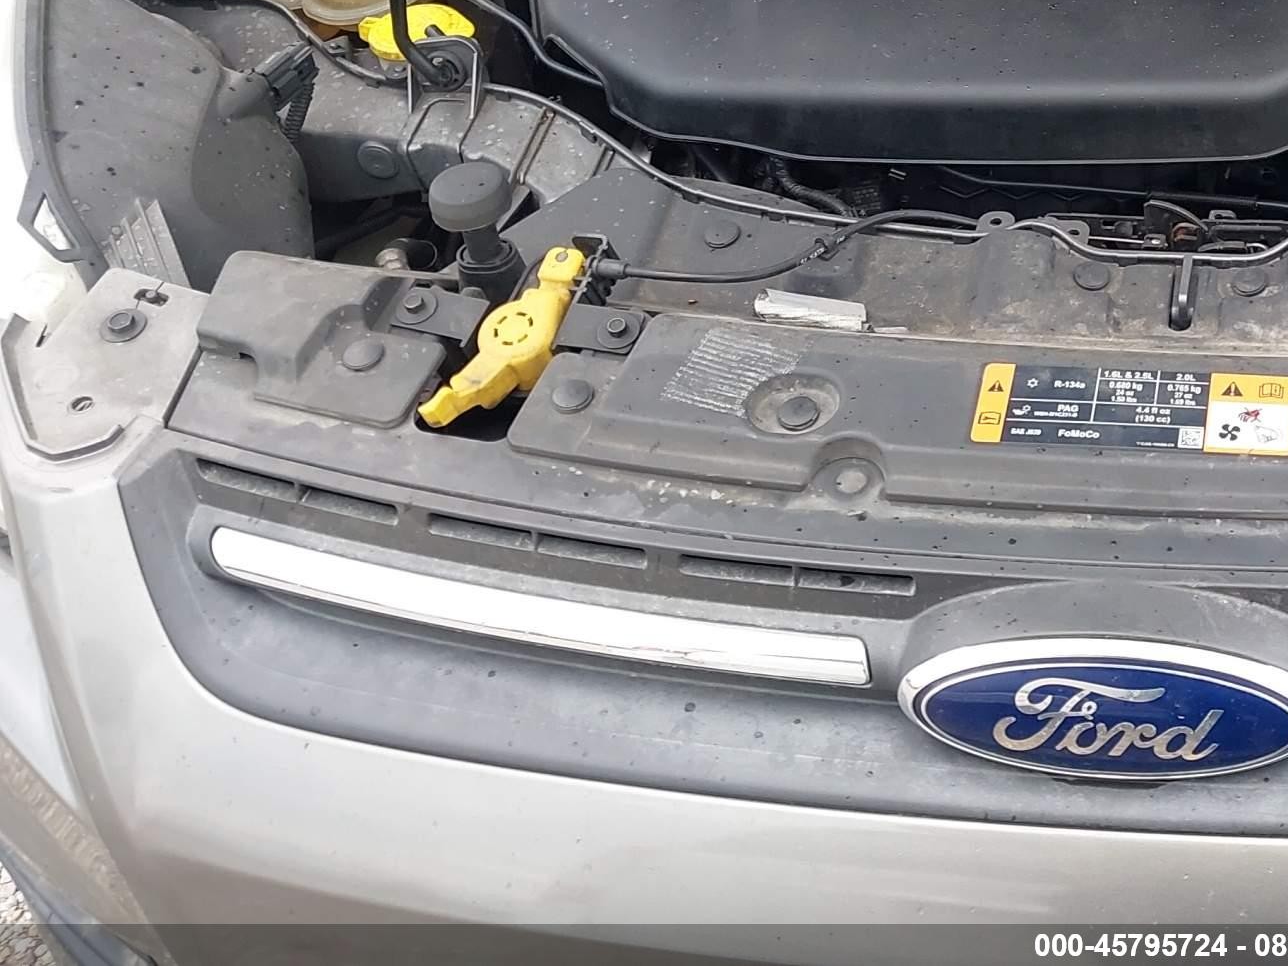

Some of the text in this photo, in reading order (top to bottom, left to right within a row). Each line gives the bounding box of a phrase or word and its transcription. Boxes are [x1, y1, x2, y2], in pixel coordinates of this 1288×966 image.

[1176, 373, 1196, 382] 2.0L
[1054, 380, 1086, 389] R-134a
[1132, 382, 1143, 392] kg
[1190, 385, 1202, 395] kg
[1057, 404, 1079, 412] PAG
[1135, 406, 1150, 414] 4.4
[1135, 414, 1171, 424] (130 cc)
[1057, 428, 1100, 439] FoMoCo
[992, 677, 1225, 761] Ford
